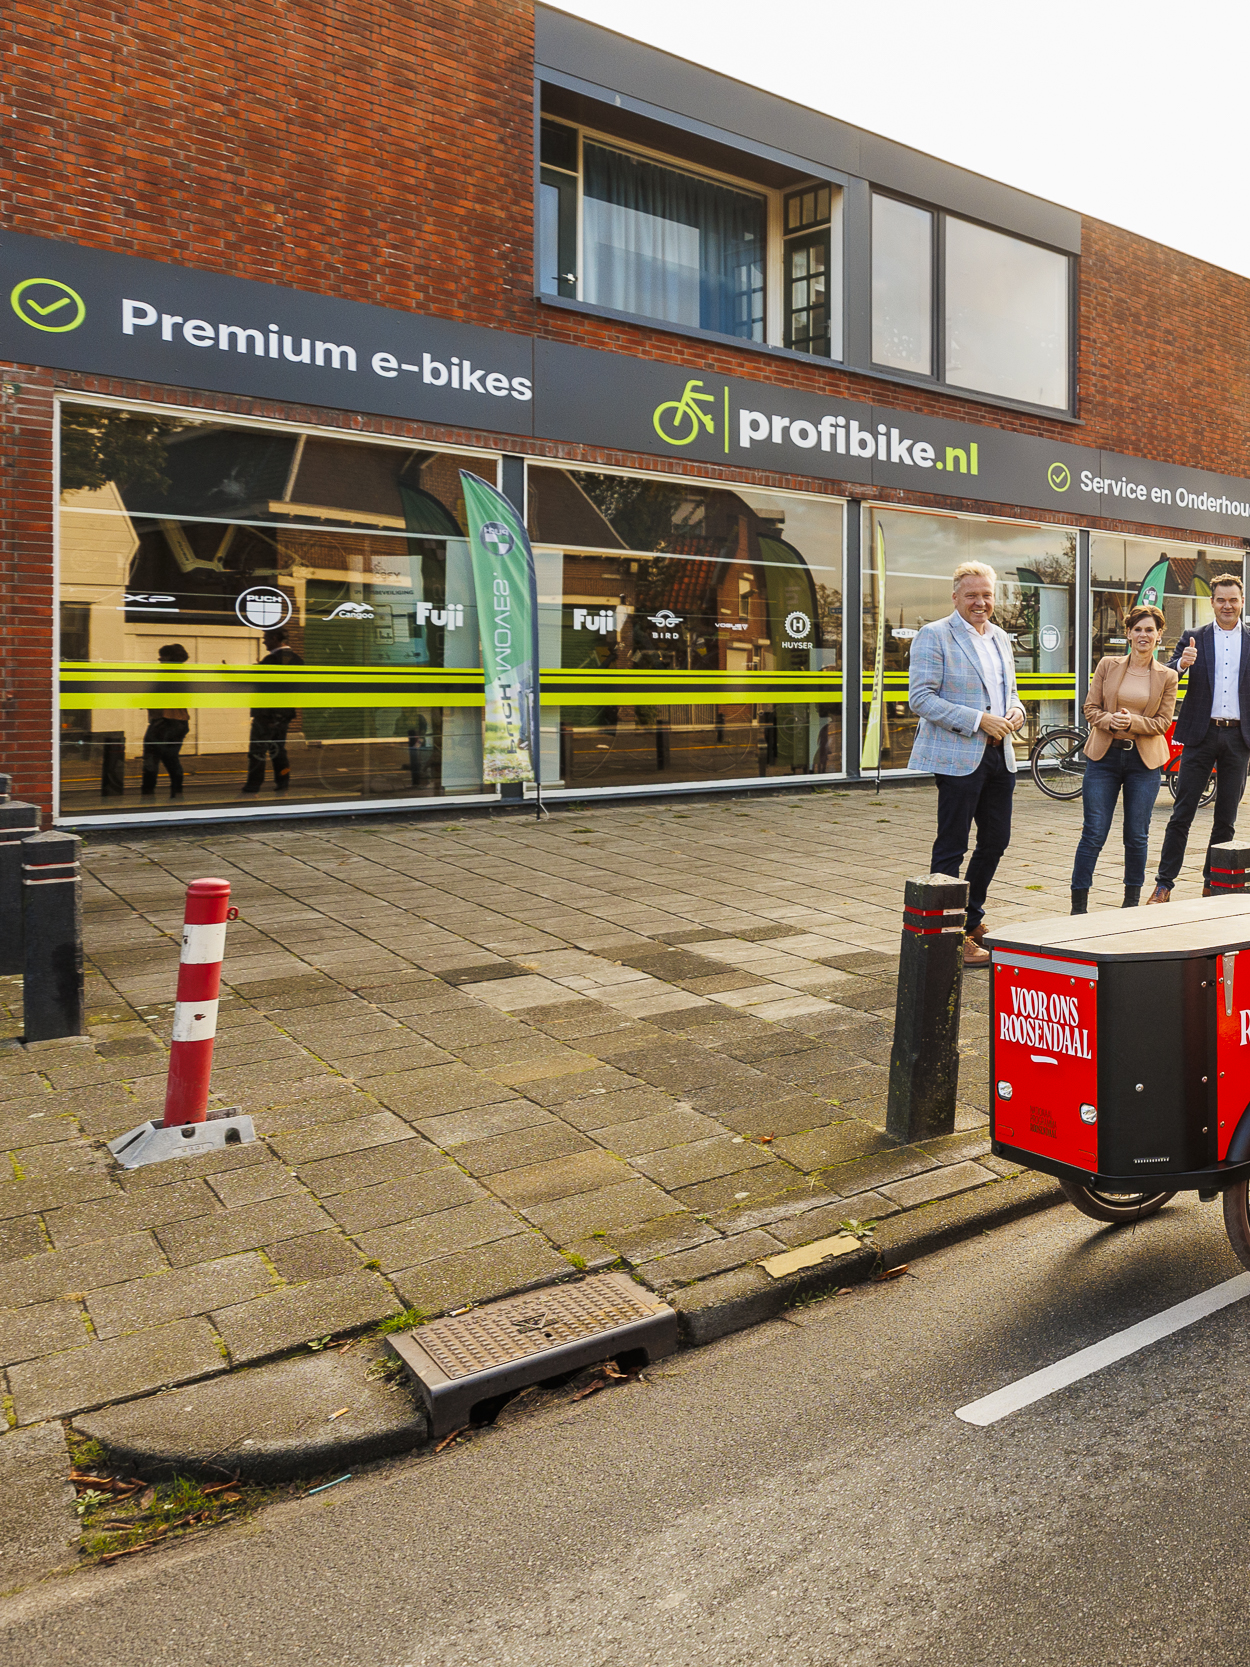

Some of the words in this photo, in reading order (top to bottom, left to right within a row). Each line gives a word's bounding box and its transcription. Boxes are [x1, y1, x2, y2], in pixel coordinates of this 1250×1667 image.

[122, 298, 357, 371] Premium
[371, 351, 532, 402] e-bikes
[739, 408, 978, 475] profibike.nl
[1080, 470, 1147, 500] Service
[1151, 485, 1173, 504] en
[120, 594, 176, 603] XP
[246, 594, 282, 602] PUCH
[338, 610, 374, 620] Cangoo
[416, 602, 464, 630] Fuji
[573, 608, 614, 635] Fuji
[792, 619, 803, 631] H
[1010, 986, 1048, 1020] VOOR
[1050, 996, 1078, 1026] ONS
[1000, 1012, 1092, 1060] ROOSENDAAL
